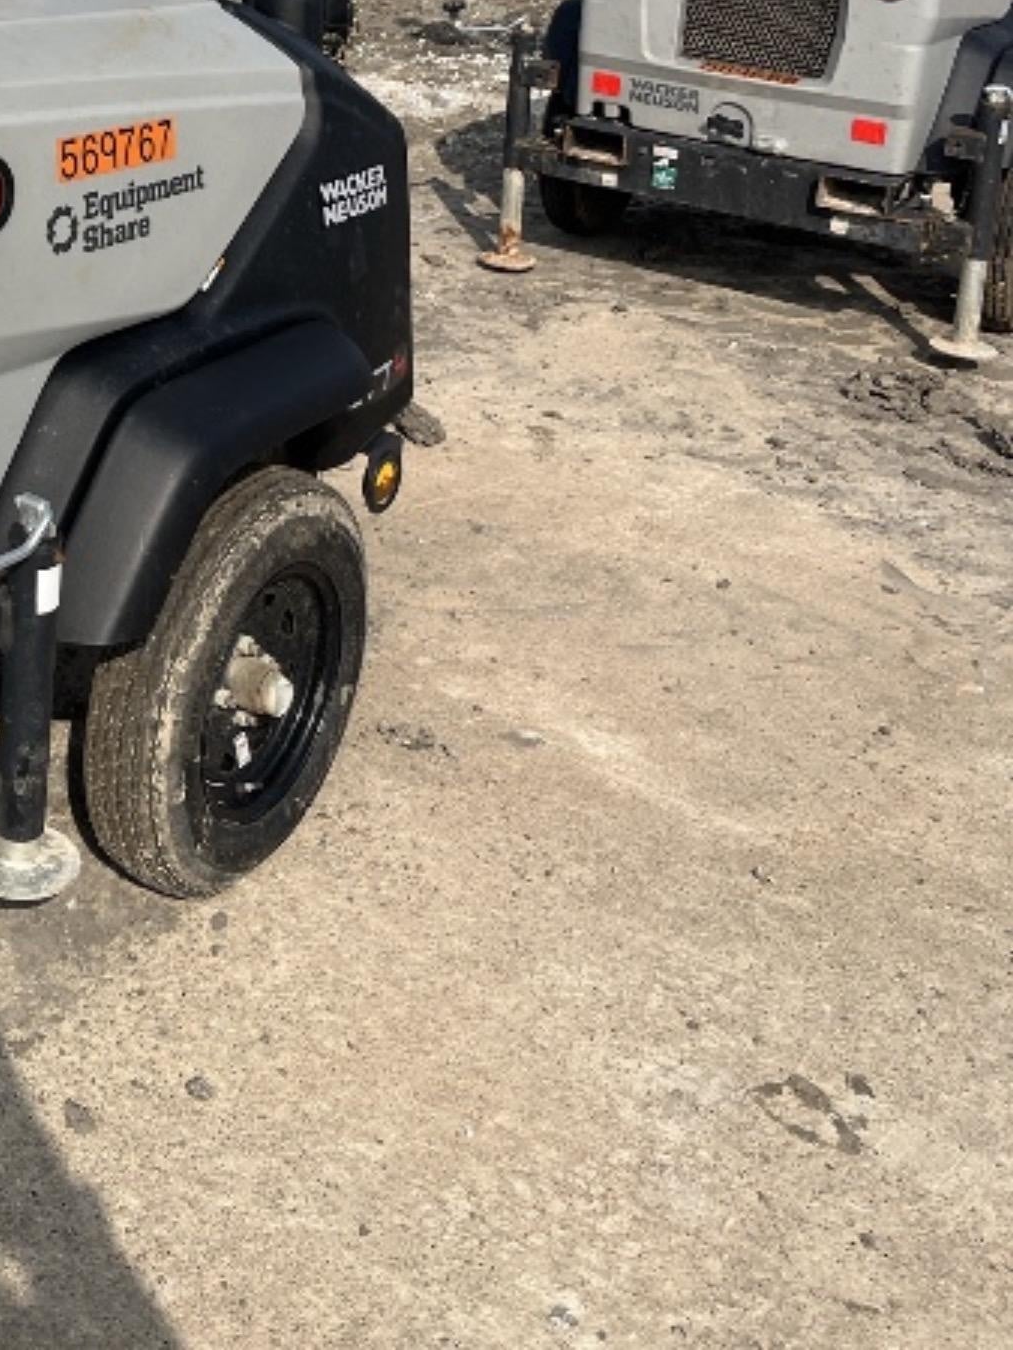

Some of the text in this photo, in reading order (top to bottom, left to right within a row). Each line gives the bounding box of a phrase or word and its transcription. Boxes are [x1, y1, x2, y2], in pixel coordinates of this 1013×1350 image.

[61, 119, 171, 181] 569767
[83, 164, 204, 220] Equipment
[319, 164, 387, 202] WACKER
[322, 185, 387, 228] NEUSON
[82, 216, 150, 253] Share
